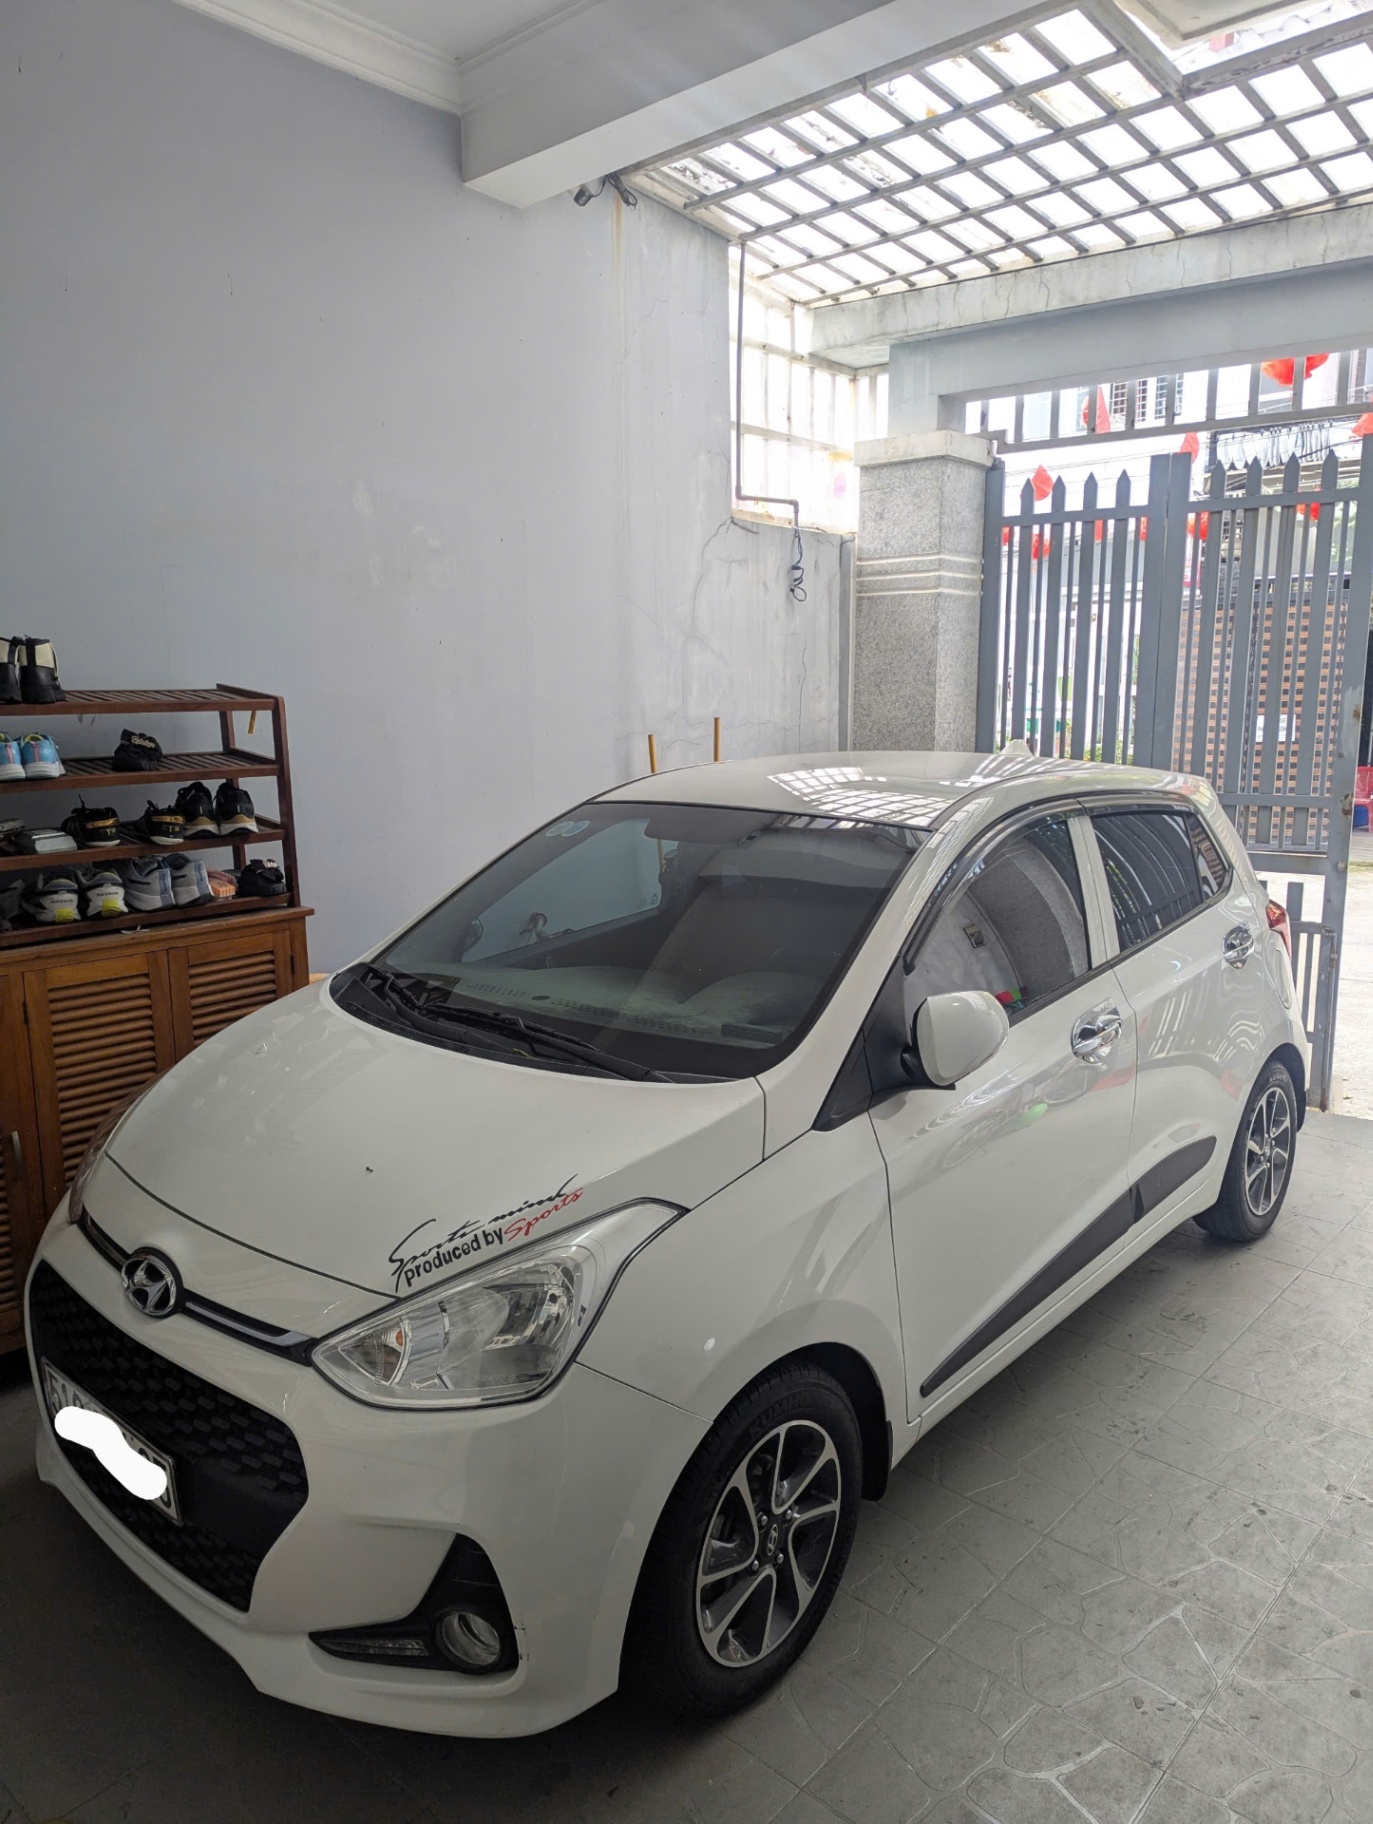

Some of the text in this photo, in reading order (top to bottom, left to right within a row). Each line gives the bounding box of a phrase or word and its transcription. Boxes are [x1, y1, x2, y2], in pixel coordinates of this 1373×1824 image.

[404, 1187, 584, 1287] produced by Sports
